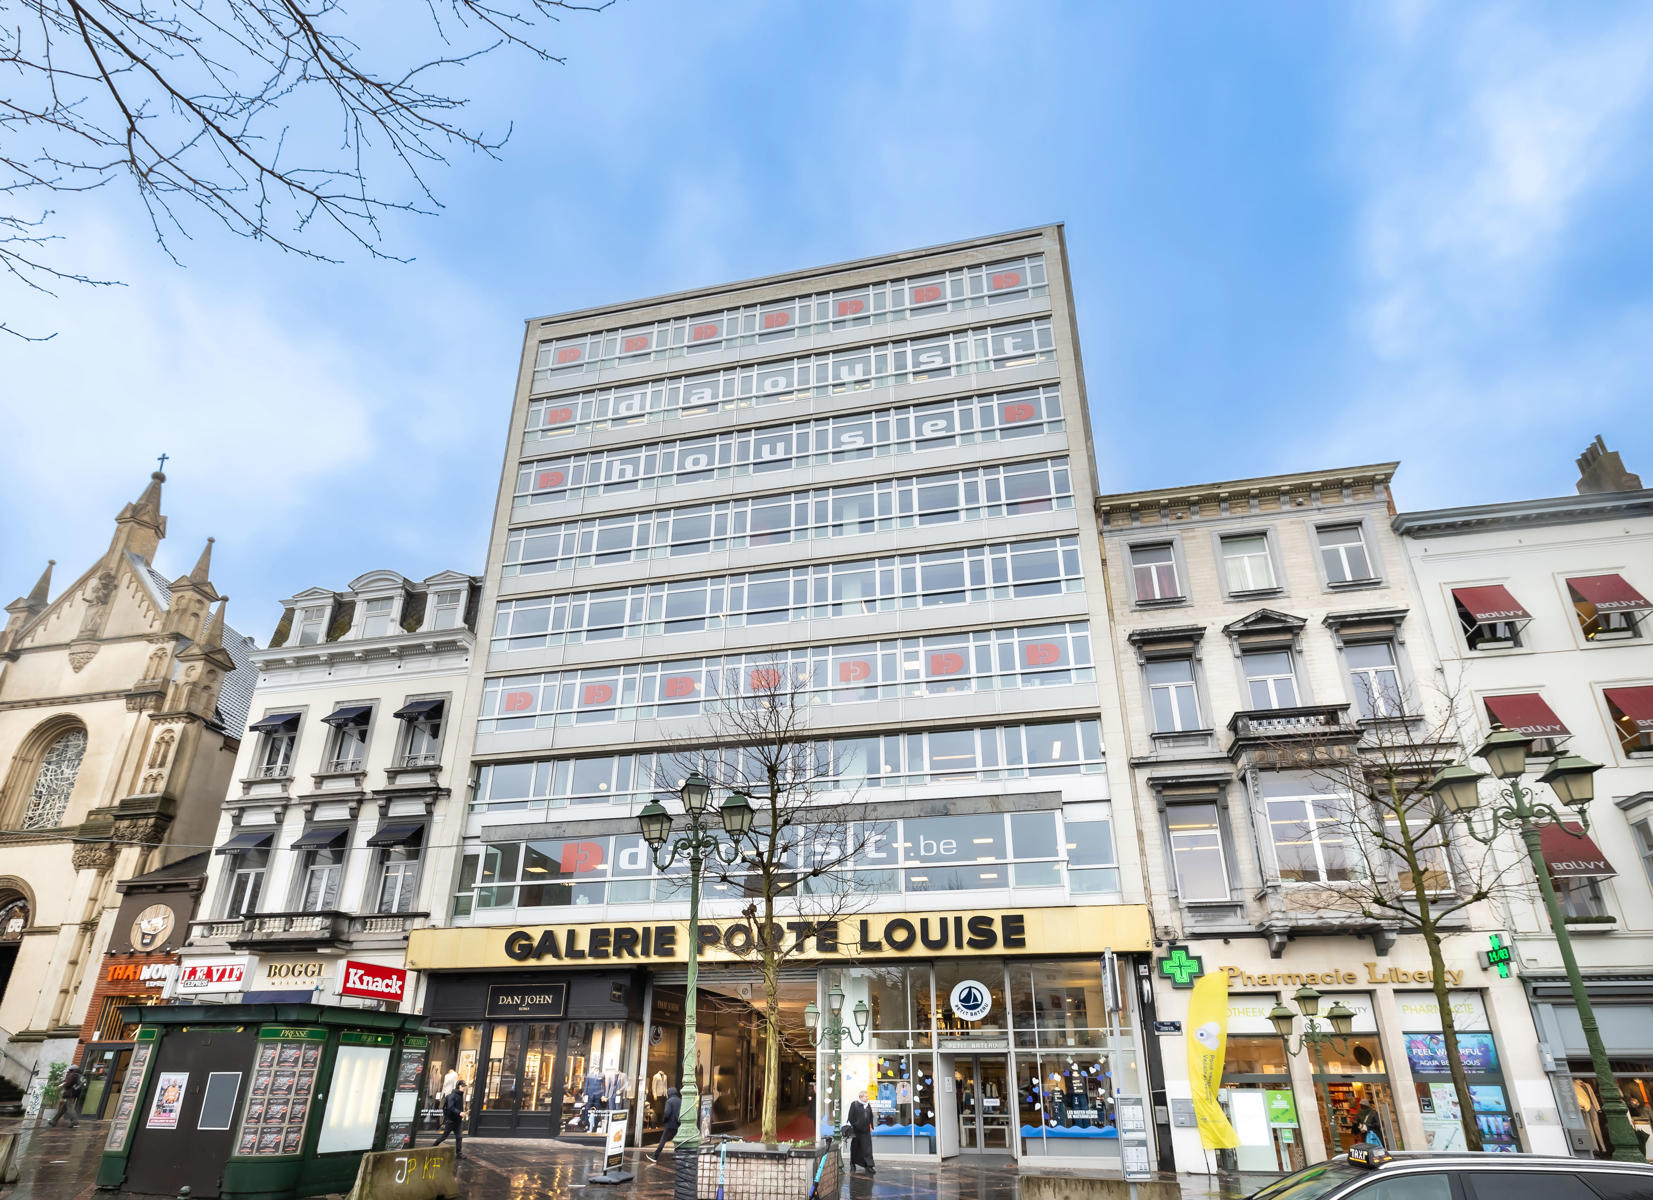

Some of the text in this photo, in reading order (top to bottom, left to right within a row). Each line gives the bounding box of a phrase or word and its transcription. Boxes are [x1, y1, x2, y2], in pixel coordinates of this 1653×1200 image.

[1596, 600, 1646, 609] BOUVY
[1476, 609, 1524, 619] BOUVY
[1550, 860, 1606, 870] BOUVY
[505, 914, 1026, 960] GALERIE PORTE LOUISE
[1488, 949, 1510, 963] 14/03
[181, 965, 244, 983] LE VIF
[267, 963, 325, 978] BOGGI
[1218, 962, 1463, 987] Pharmacie Libery
[346, 968, 402, 994] Knack
[498, 995, 552, 1006] DAN JOHN
[954, 1003, 989, 1016] PETIT BATEAU
[1225, 1007, 1266, 1017] OTHEEK
[1413, 1048, 1434, 1056] FEEL
[1350, 1148, 1368, 1160] TAXI
